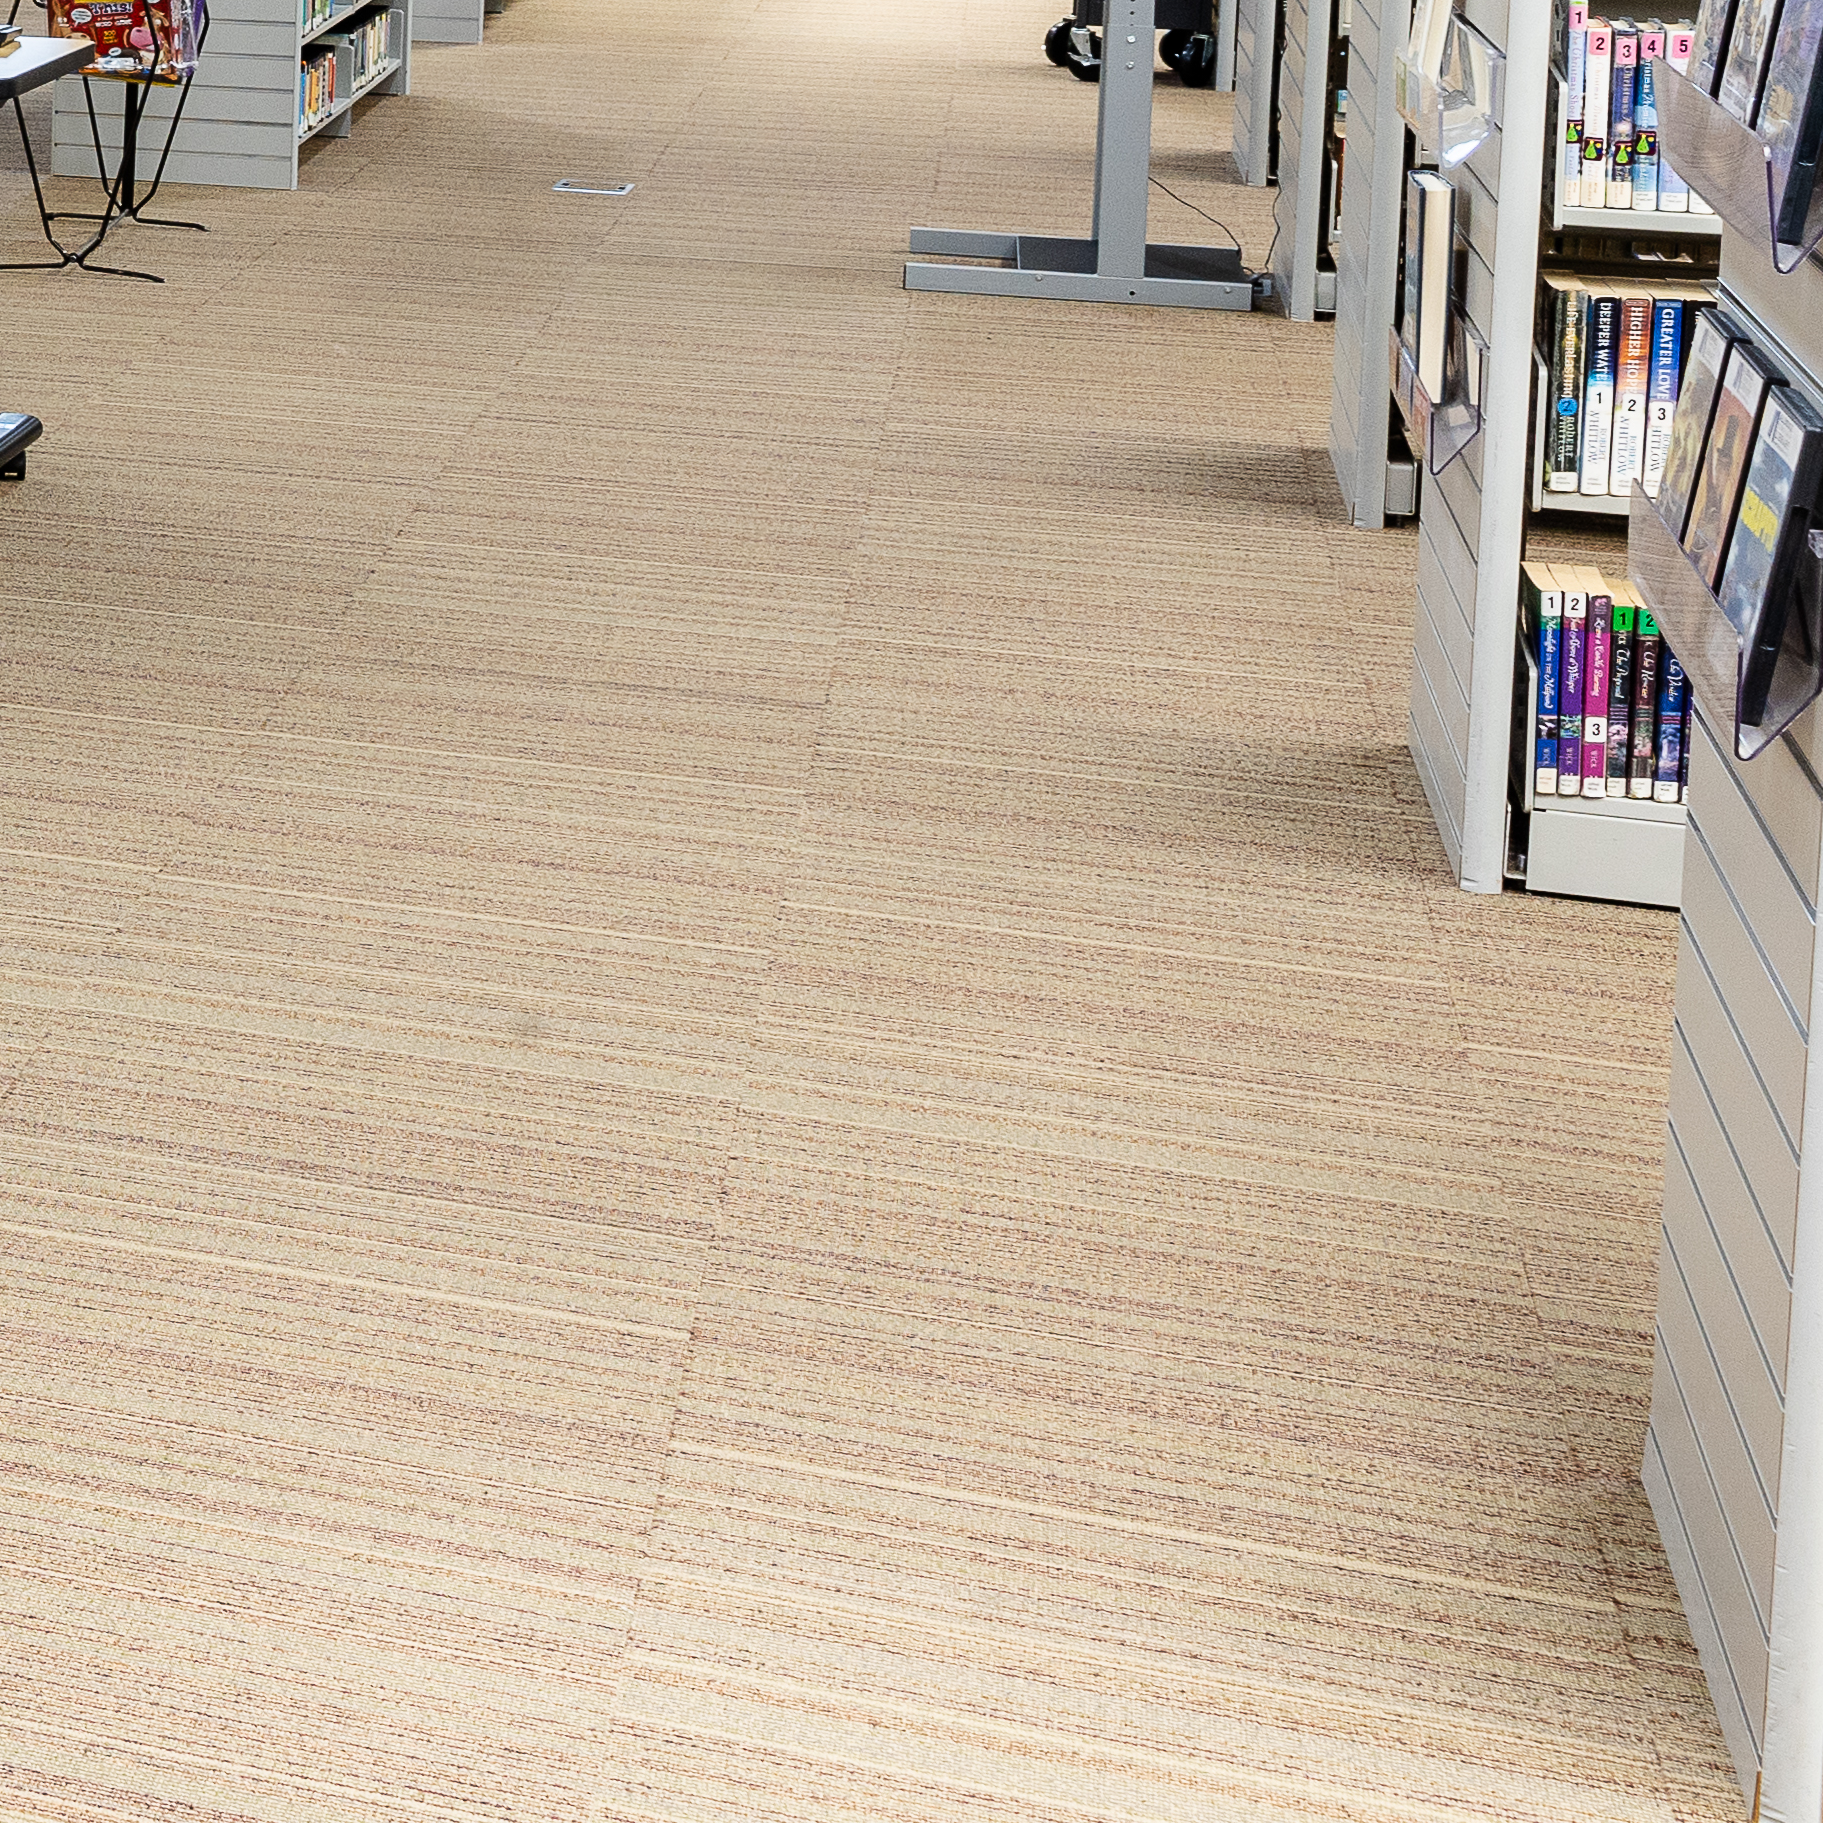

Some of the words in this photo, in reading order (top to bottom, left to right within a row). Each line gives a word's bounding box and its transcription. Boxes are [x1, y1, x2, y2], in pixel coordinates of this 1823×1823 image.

[1628, 307, 1643, 357] HIGHER
[1659, 308, 1675, 365] GREATER
[1657, 369, 1672, 400] LOVE
[1587, 411, 1600, 464] WHITLOW
[1617, 416, 1630, 475] WHITLOW
